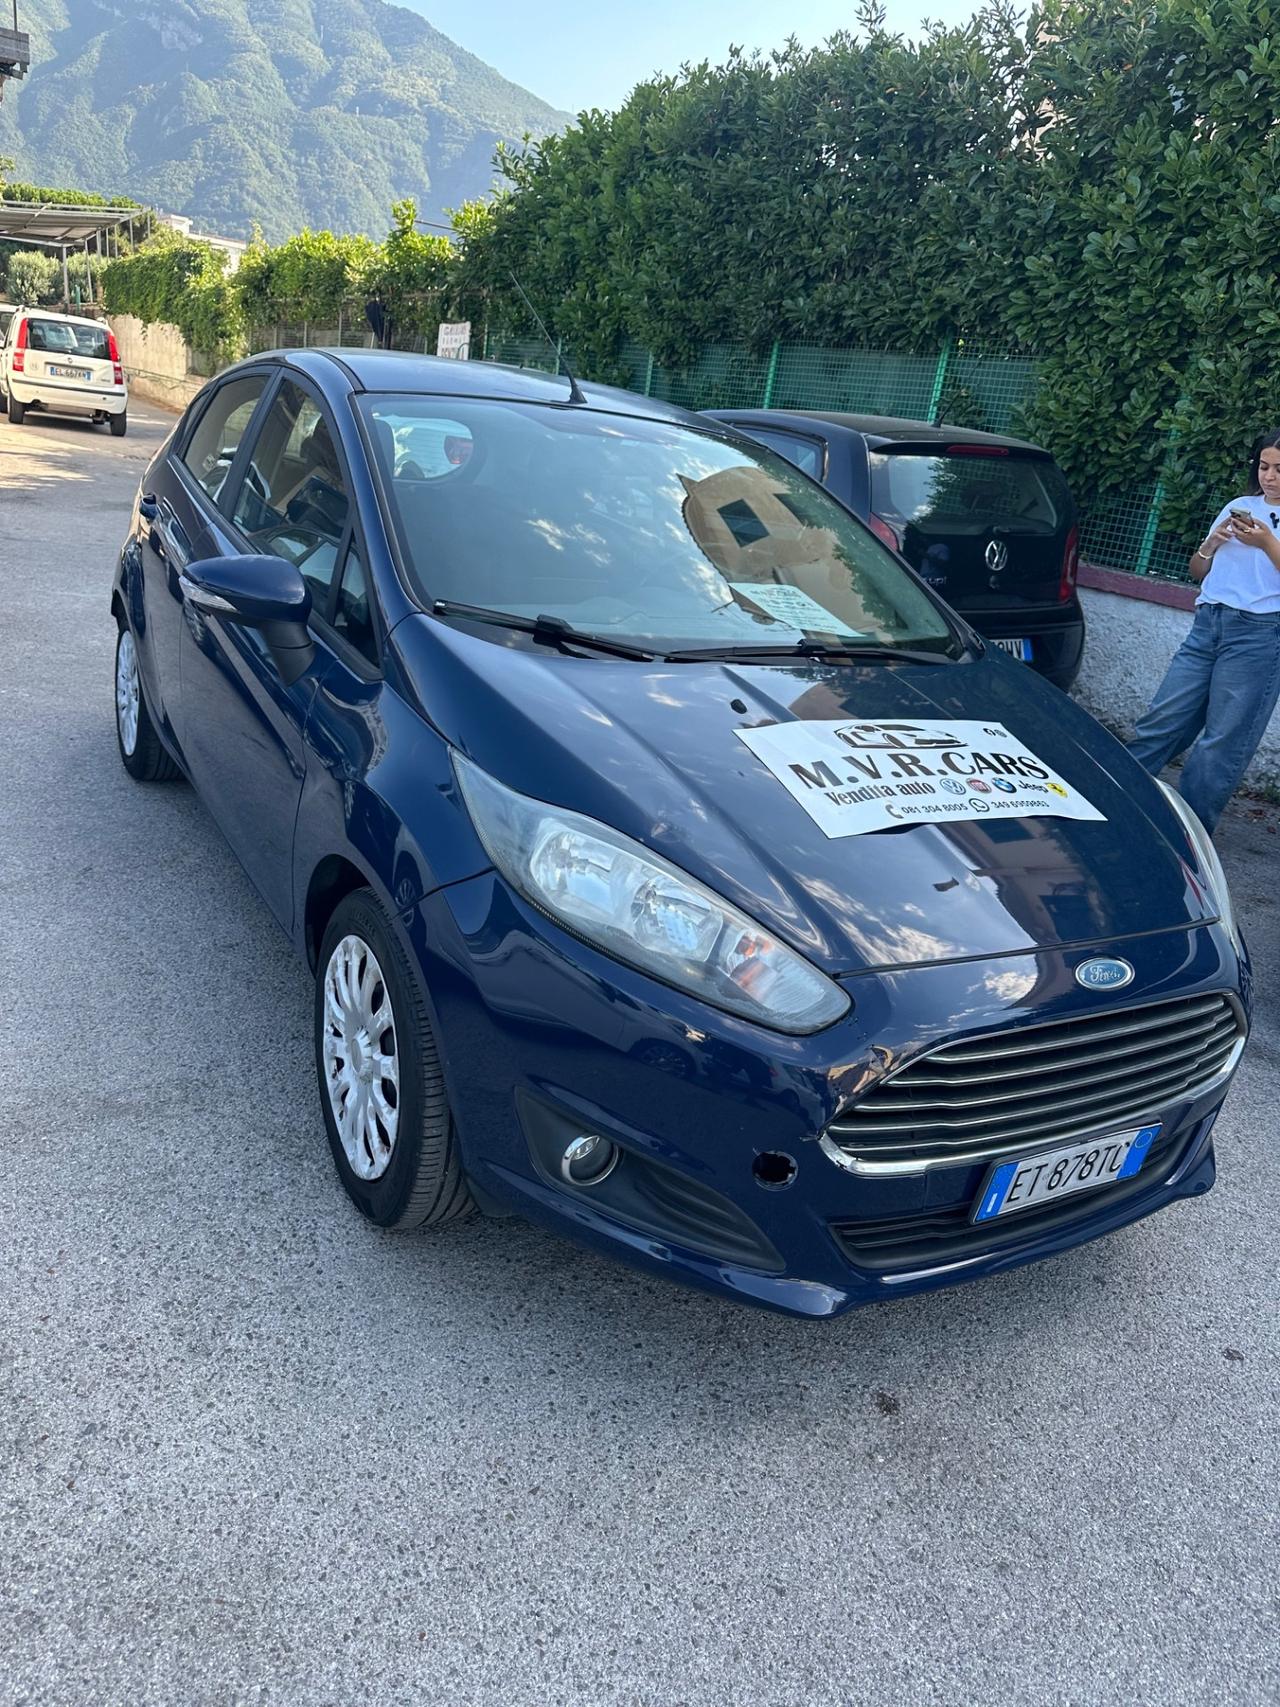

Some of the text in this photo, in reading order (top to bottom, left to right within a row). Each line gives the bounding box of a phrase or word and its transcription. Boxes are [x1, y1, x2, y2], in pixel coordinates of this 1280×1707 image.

[788, 752, 1049, 789] M.V.R.CARS
[824, 781, 936, 806] Vendita auto
[901, 806, 921, 814] 081
[922, 805, 942, 813] 304
[942, 803, 968, 812] 8005
[1007, 1142, 1130, 1202] ET878TC
